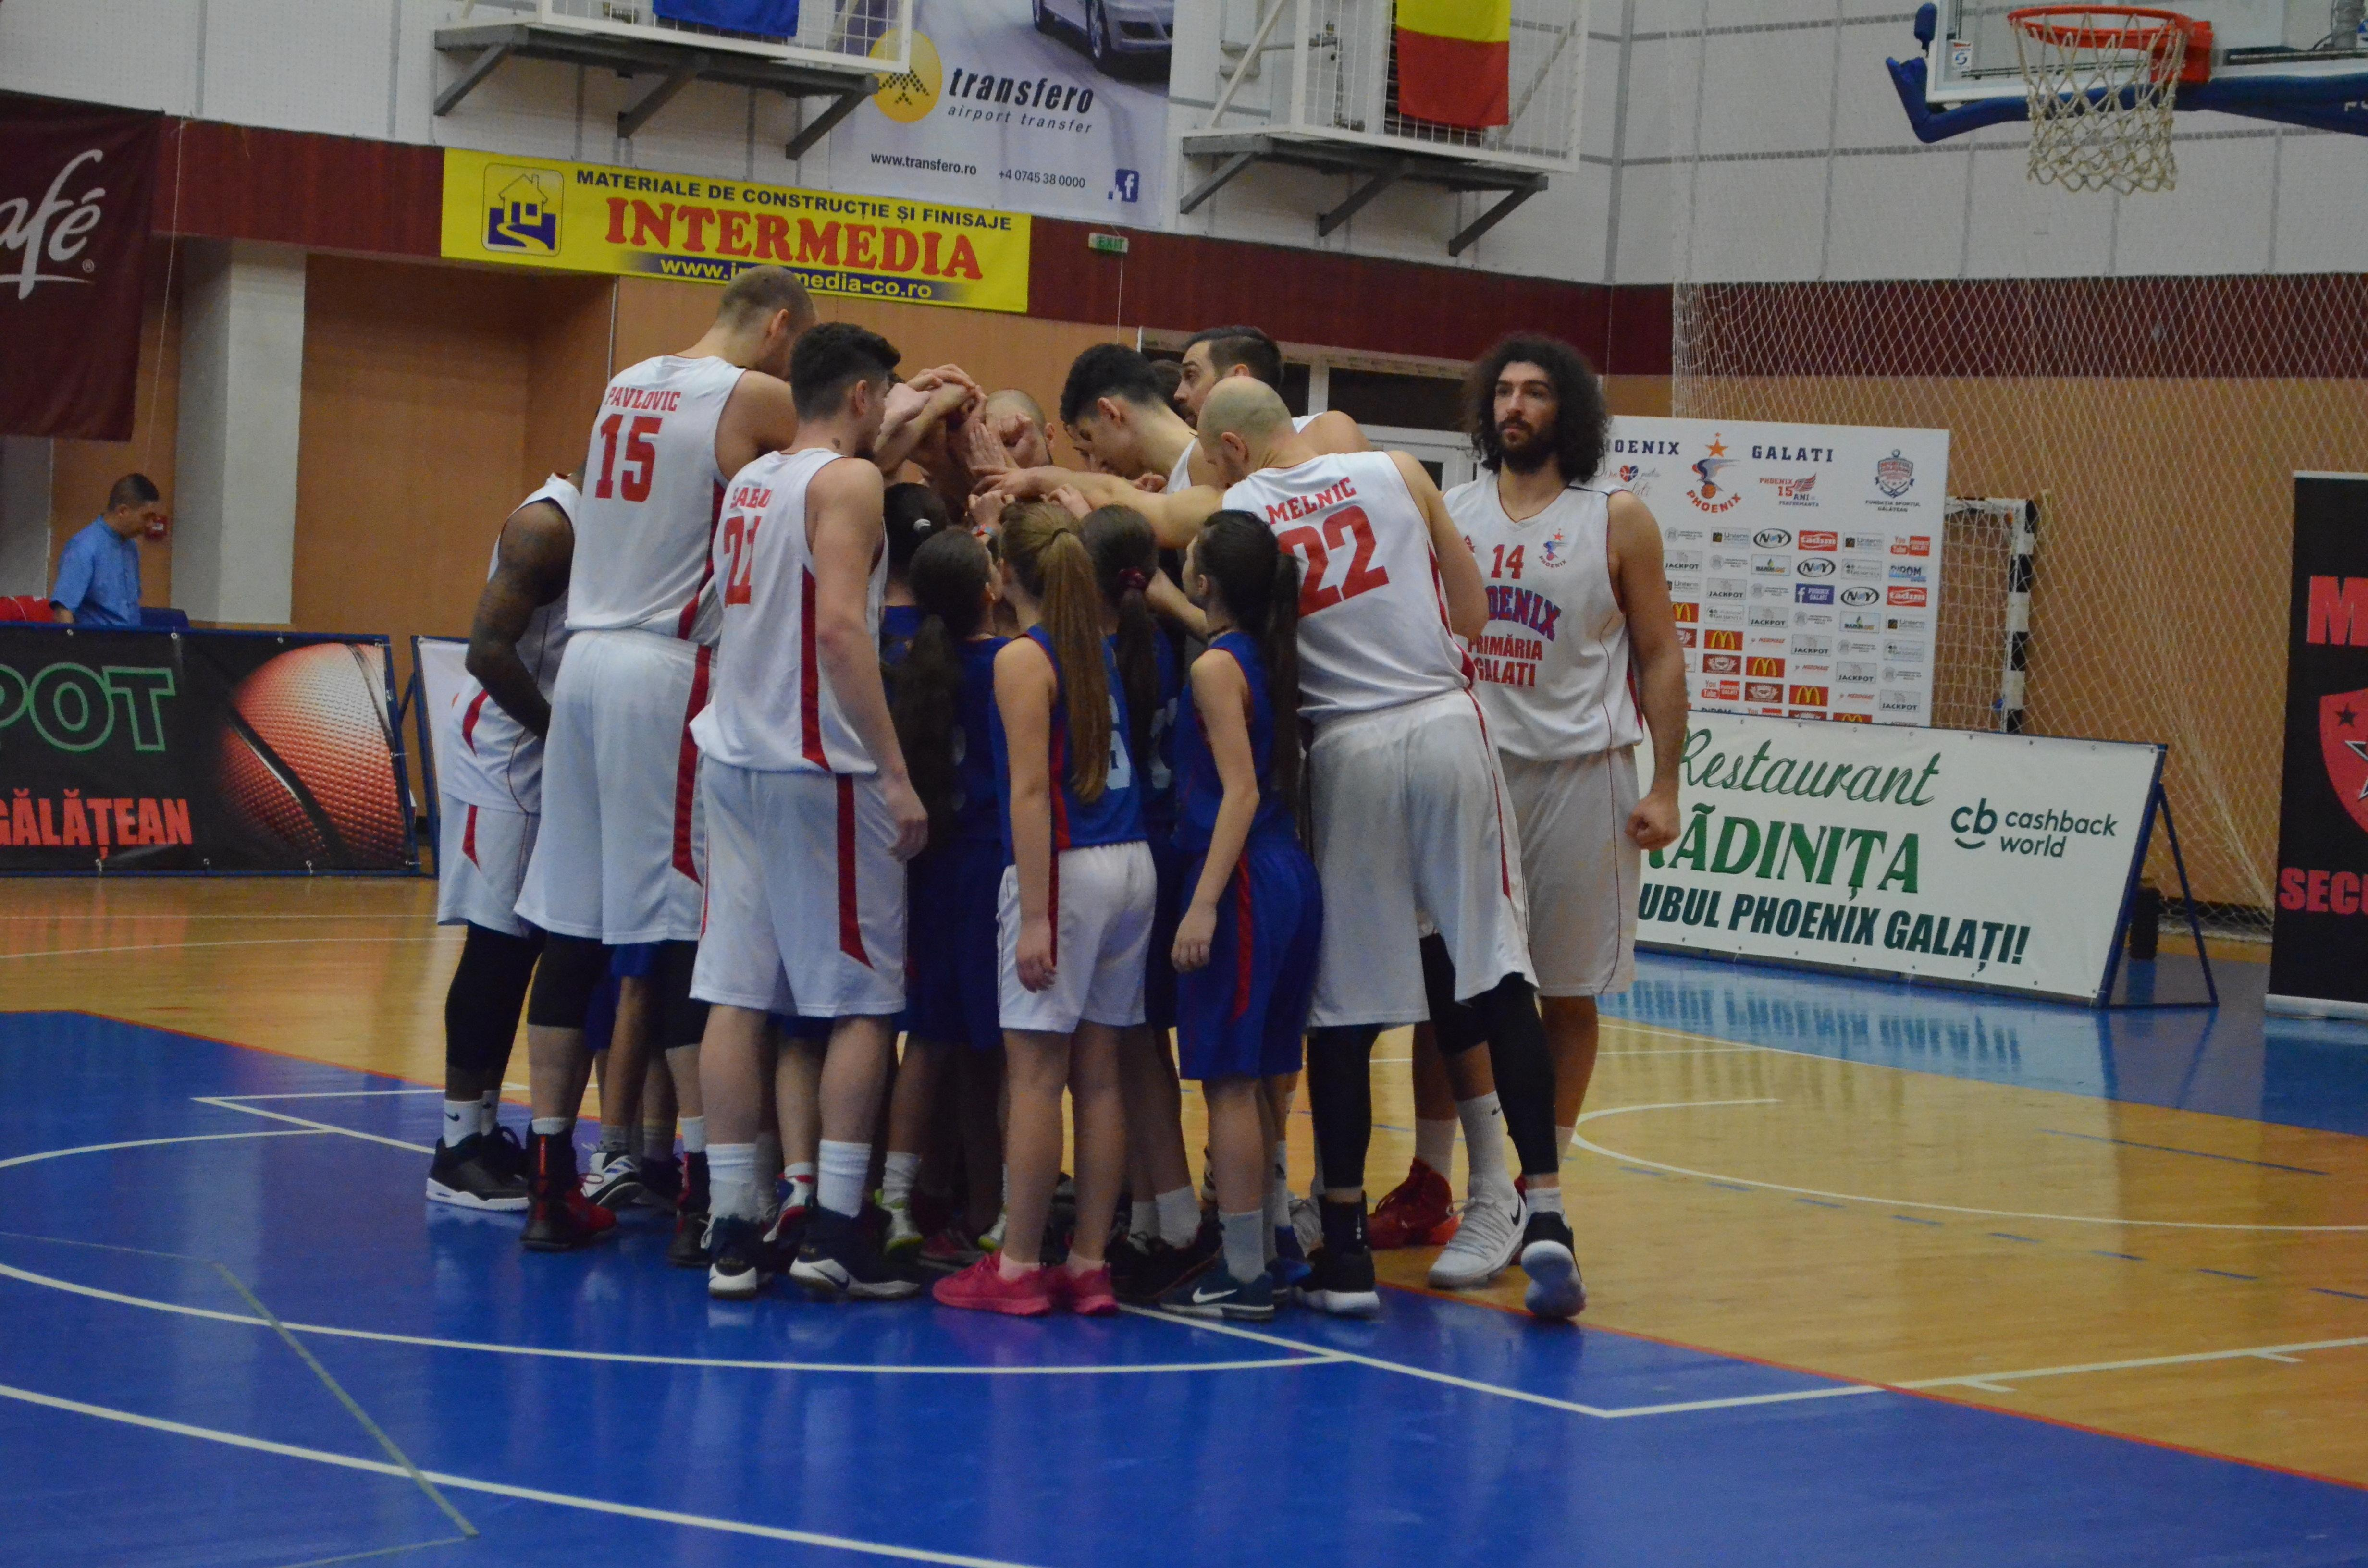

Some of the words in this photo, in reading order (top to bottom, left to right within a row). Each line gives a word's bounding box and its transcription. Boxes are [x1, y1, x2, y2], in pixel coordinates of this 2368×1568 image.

[949, 68, 1094, 114] transfero
[948, 104, 1011, 123] airport
[1021, 112, 1093, 134] transfer
[871, 153, 976, 175] www.transfero.ro
[1014, 170, 1041, 183] 0745
[1043, 173, 1057, 184] 38
[1059, 175, 1085, 188] 0000
[577, 170, 700, 197] MATERIALE
[708, 185, 735, 201] DE
[742, 189, 889, 220] CONSTRUCȚIE
[923, 208, 1011, 231] FINISAJE
[605, 197, 983, 280] INTERMEDIA
[660, 258, 932, 299] www.imedia-co.ro
[604, 387, 681, 412] PAVLOVIC
[595, 413, 663, 502] 15
[1752, 445, 1834, 463] GALATI
[1265, 477, 1357, 525] MELNIC
[1687, 489, 1742, 513] PHOENIX
[1778, 486, 1793, 497] 15
[1278, 505, 1390, 619] 22
[1491, 544, 1525, 579] 14
[1882, 703, 1918, 711] JACKPOT
[1679, 727, 1942, 807] Restaurant
[1950, 797, 1998, 835] cb
[2005, 808, 2119, 837] cashback
[2000, 834, 2067, 858] world
[2279, 867, 2368, 916] SEC
[1727, 893, 1881, 946] PHOENIX
[1883, 910, 2031, 973] GALAȚI!
